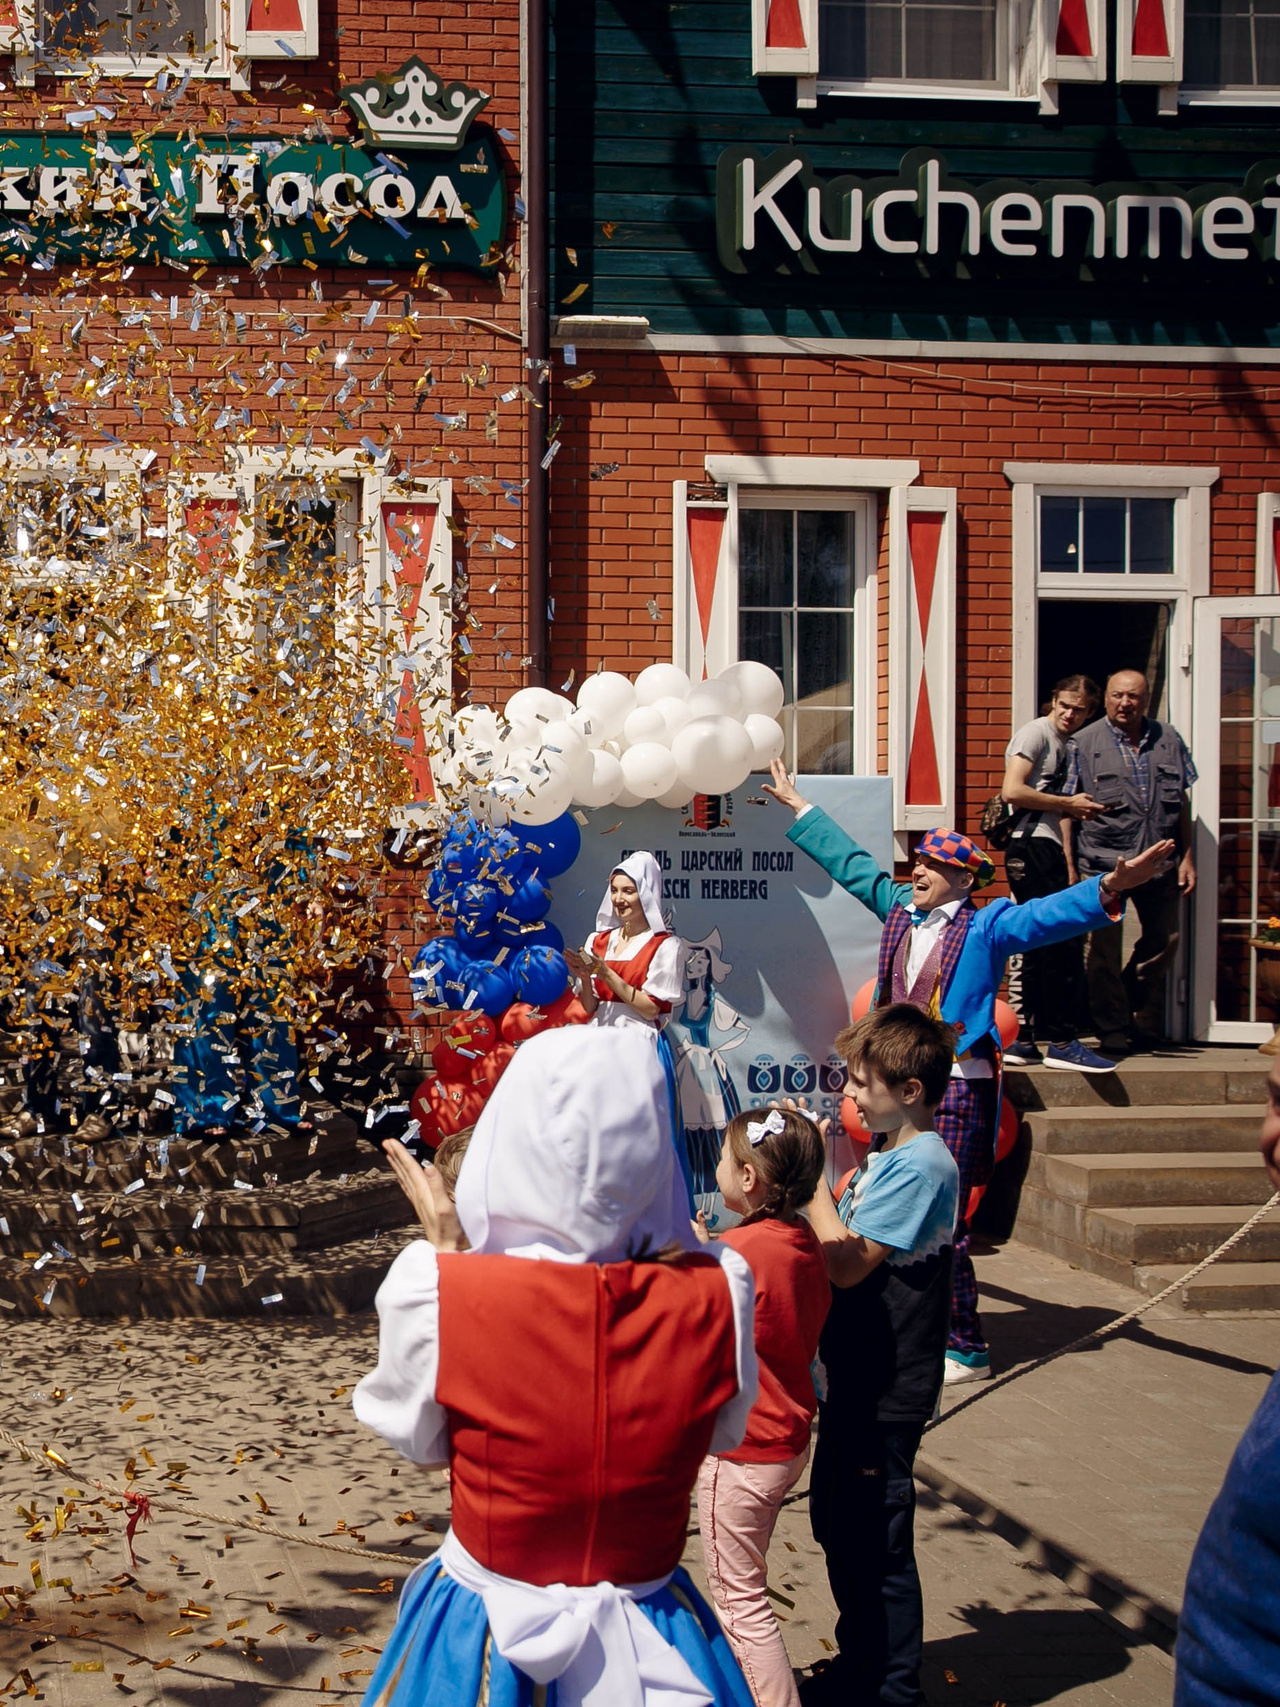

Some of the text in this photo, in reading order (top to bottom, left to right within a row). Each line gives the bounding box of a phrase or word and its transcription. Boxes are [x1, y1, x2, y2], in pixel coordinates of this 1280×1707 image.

[195, 153, 466, 219] Посол
[681, 848, 743, 873] ЦАРСКИЙ
[752, 851, 794, 872] ПОСОЛ
[701, 879, 768, 900] HERBERG
